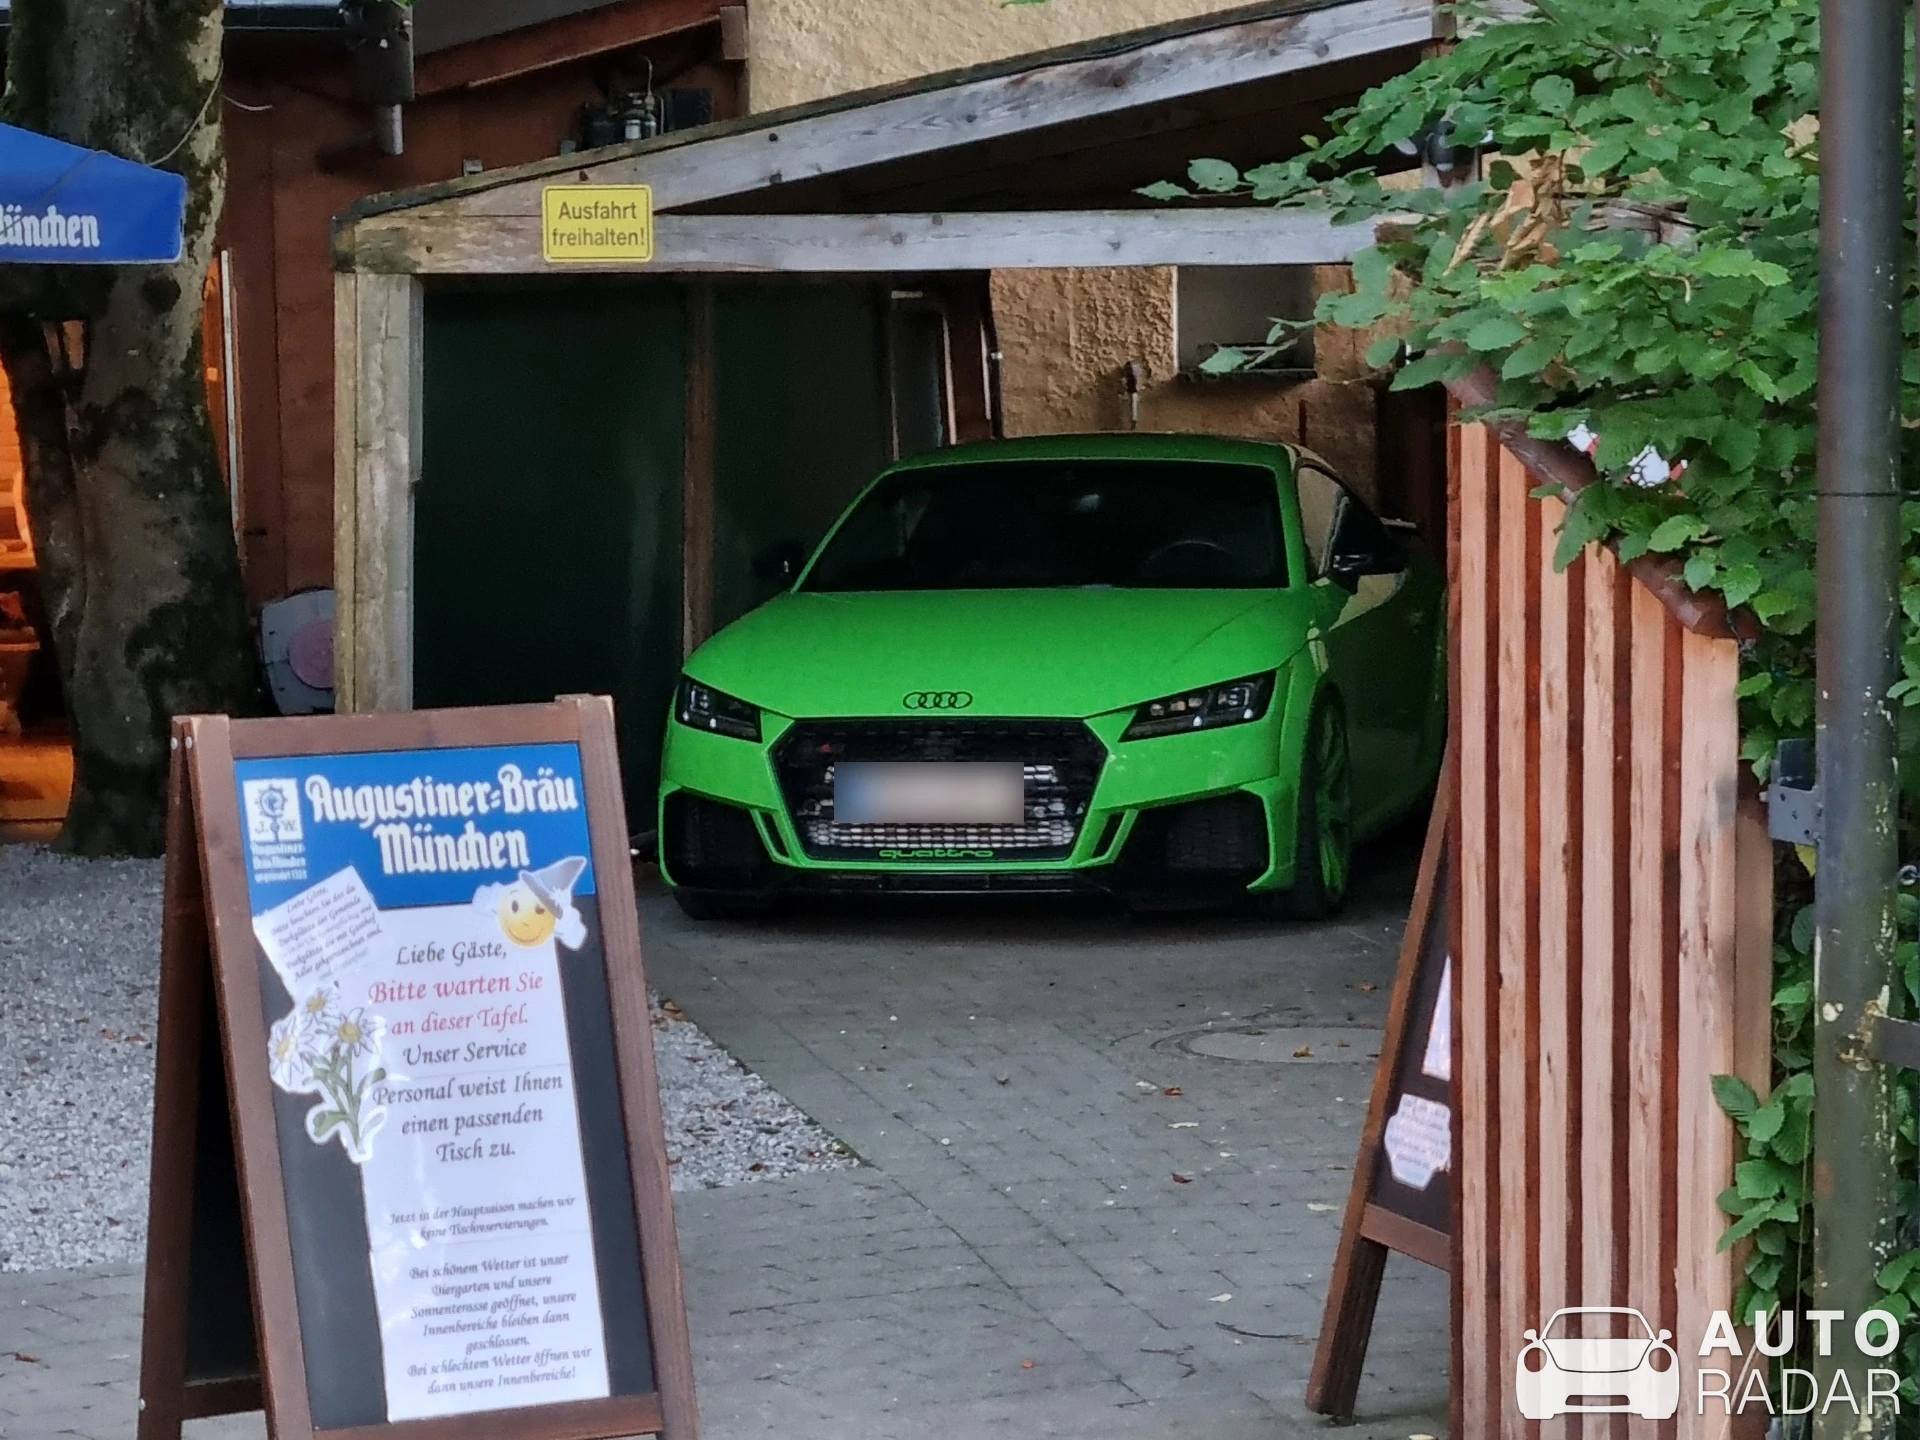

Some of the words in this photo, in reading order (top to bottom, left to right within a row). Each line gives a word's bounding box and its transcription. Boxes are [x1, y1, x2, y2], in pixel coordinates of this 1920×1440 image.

[558, 201, 637, 220] Ausfahrt
[552, 227, 645, 246] freihalten!
[372, 820, 531, 876] München
[879, 849, 994, 859] quattro
[396, 942, 445, 965] Liebe
[452, 941, 507, 966] Gäste,
[368, 980, 426, 1003] Bitte
[433, 976, 511, 998] warten
[516, 971, 543, 992] Sie
[392, 1020, 414, 1035] an
[421, 1012, 475, 1033] dieser
[477, 1003, 528, 1033] Tafel.
[403, 1045, 459, 1066] Unser
[464, 1037, 527, 1062] Service
[373, 1077, 455, 1105] Personal
[458, 1077, 506, 1098] weist
[513, 1072, 563, 1092] Ihnen
[401, 1115, 448, 1134] einen
[454, 1103, 543, 1136] passenden
[436, 1138, 482, 1162] Tisch
[489, 1142, 515, 1158] zu.
[390, 1212, 416, 1225] Jetzt
[419, 1211, 430, 1221] in
[433, 1207, 449, 1220] der
[451, 1203, 515, 1220] Hauptsaison
[518, 1196, 554, 1210] machen
[557, 1194, 576, 1207] wir
[420, 1227, 447, 1240] keine
[409, 1266, 429, 1280] Bei
[432, 1262, 478, 1278] schönem
[481, 1258, 521, 1271] Wetter
[523, 1256, 537, 1268] ist
[540, 1254, 569, 1266] unser
[432, 1281, 490, 1298] Biergarten
[493, 1275, 516, 1291] und
[518, 1275, 552, 1288] unsere
[411, 1302, 488, 1319] Sonnenterasse
[490, 1295, 538, 1316] geöffnet,
[543, 1292, 576, 1305] unsere
[423, 1317, 498, 1336] Innenbereiche
[501, 1314, 539, 1328] bleiben
[543, 1310, 569, 1324] dann
[407, 1364, 427, 1377] Bei
[430, 1358, 489, 1375] schlechtem
[492, 1354, 532, 1368] Wetter
[534, 1349, 569, 1367] öffnen
[573, 1346, 592, 1358] wir
[428, 1380, 456, 1395] dann
[459, 1377, 494, 1391] unsere
